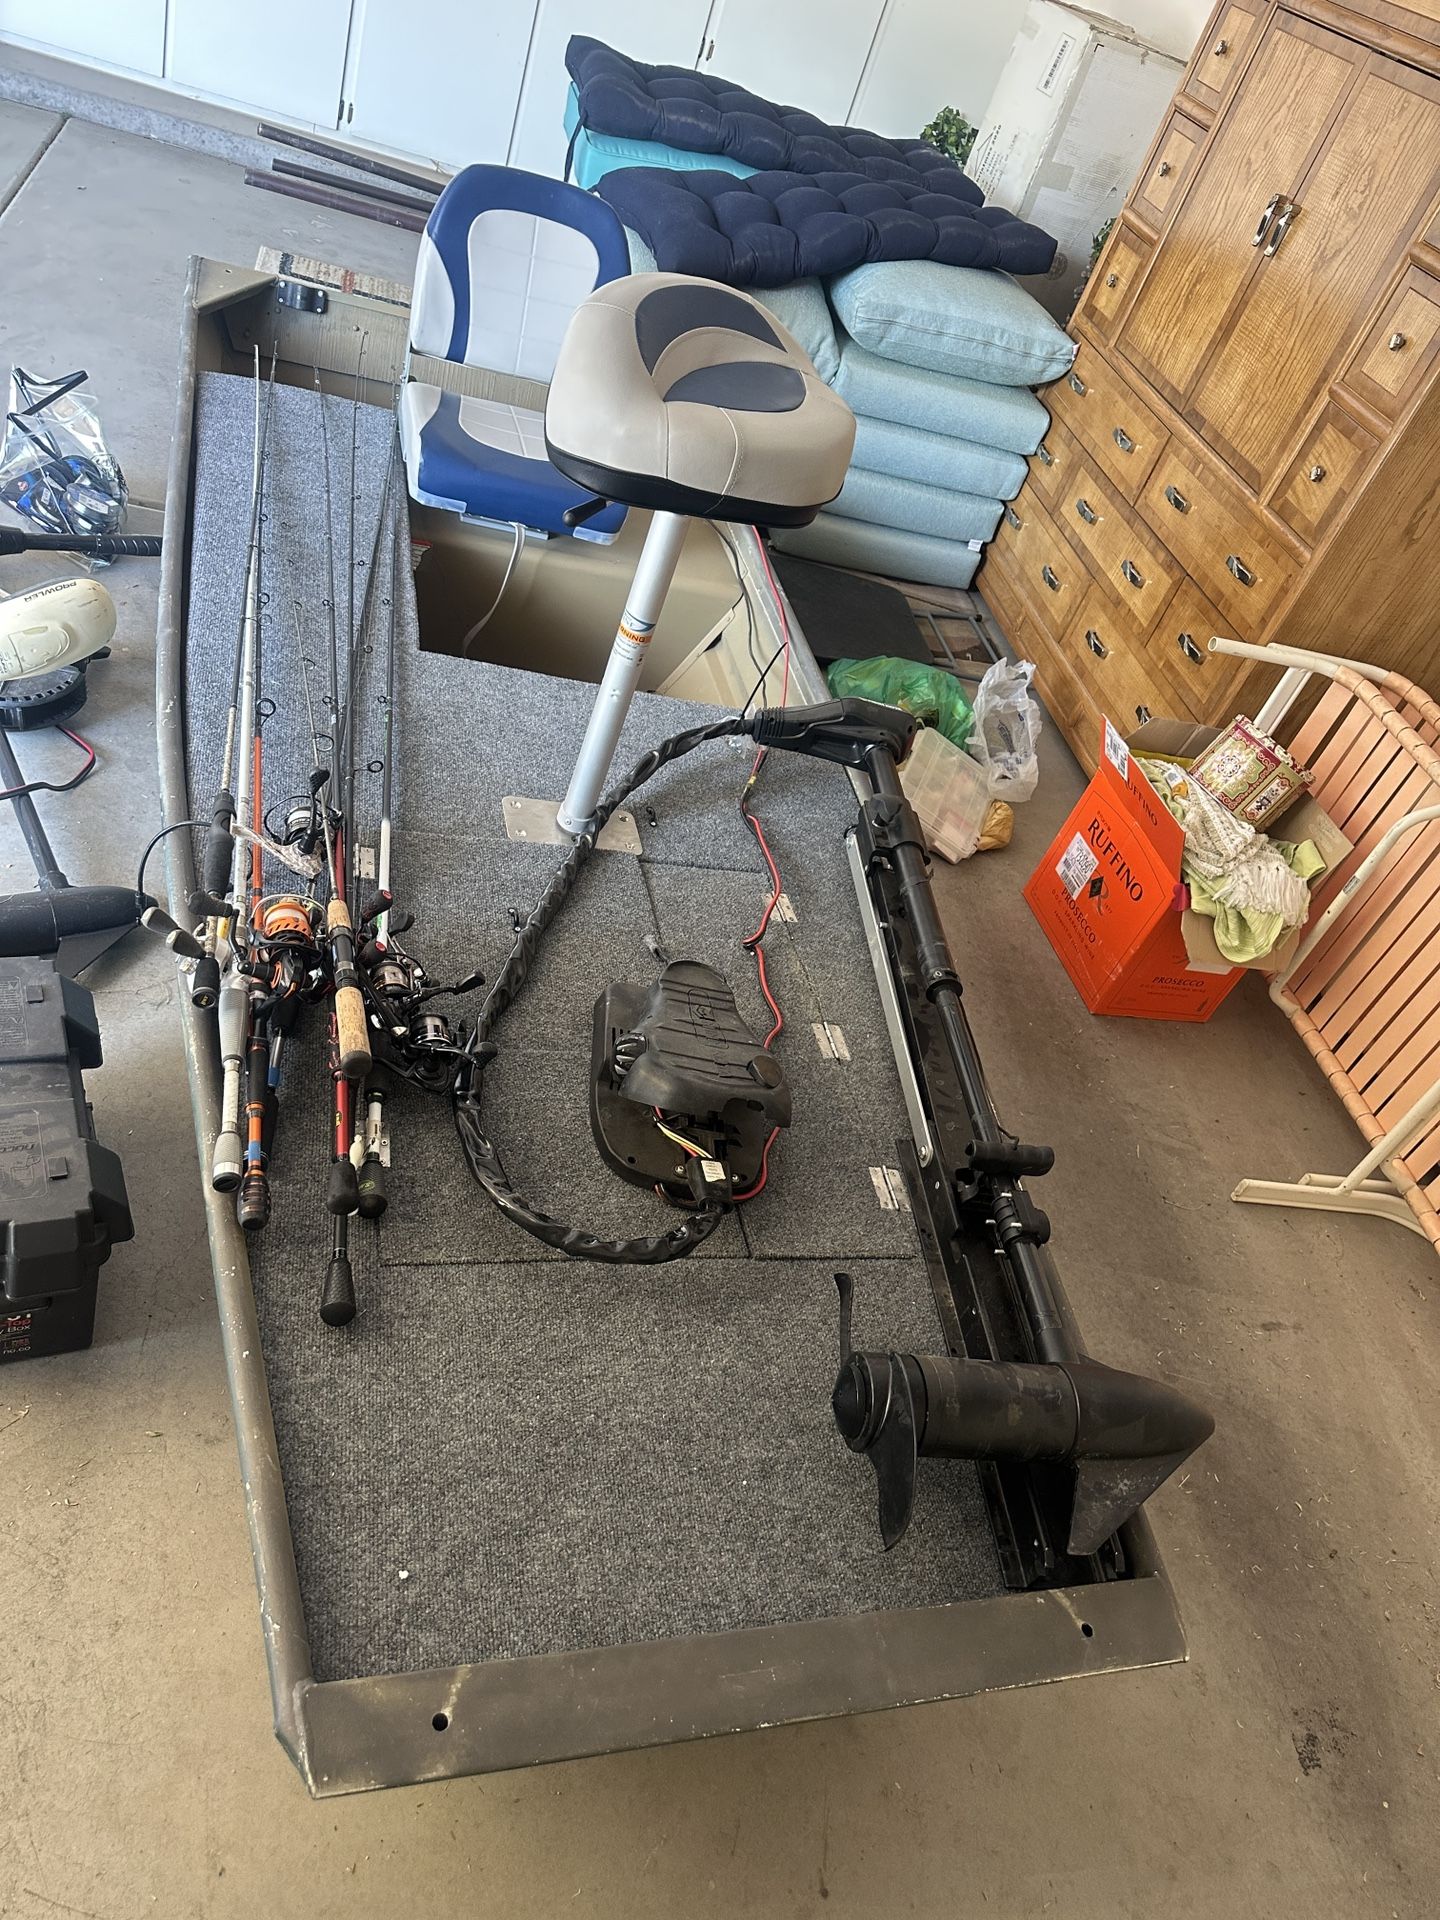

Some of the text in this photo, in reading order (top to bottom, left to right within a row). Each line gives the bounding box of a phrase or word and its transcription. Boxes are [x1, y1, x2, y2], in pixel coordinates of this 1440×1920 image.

[24, 581, 77, 602] PROWLER
[1125, 779, 1158, 826] UFFINO
[1088, 817, 1143, 901] RUFFINO
[1062, 887, 1096, 943] PROSECCO
[1152, 976, 1205, 987] PROSECCO
[8, 1325, 31, 1333] Box
